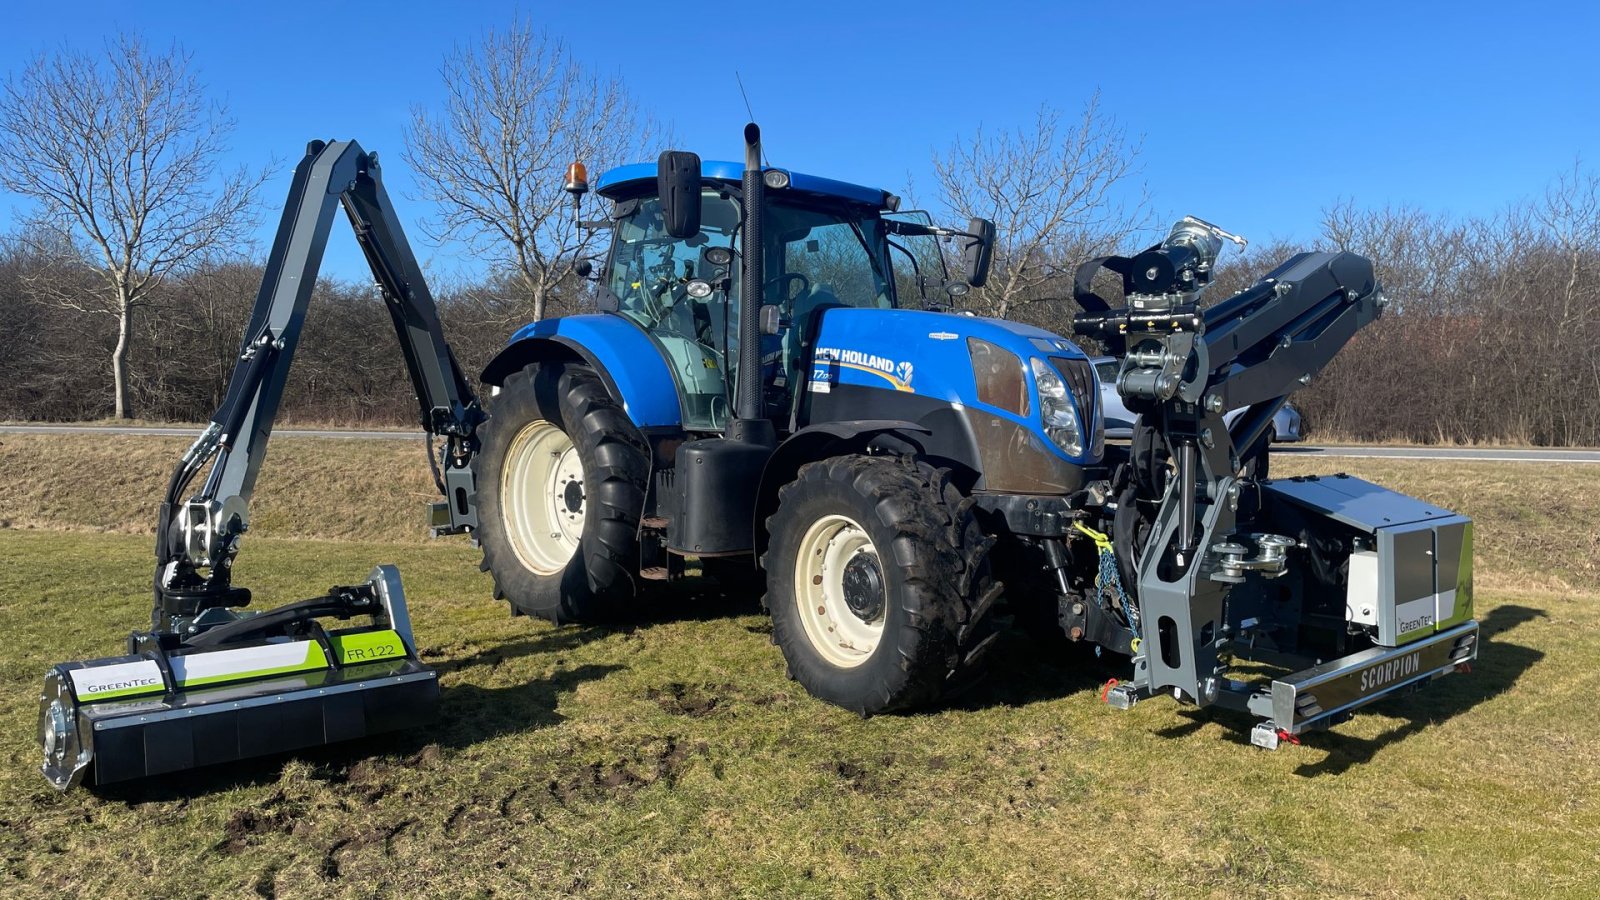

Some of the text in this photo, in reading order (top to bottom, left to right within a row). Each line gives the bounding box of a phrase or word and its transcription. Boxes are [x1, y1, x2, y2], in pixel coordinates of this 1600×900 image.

[815, 347, 895, 373] NEW HOLLAND
[347, 644, 396, 660] FR 122
[1360, 651, 1420, 692] SCORPION
